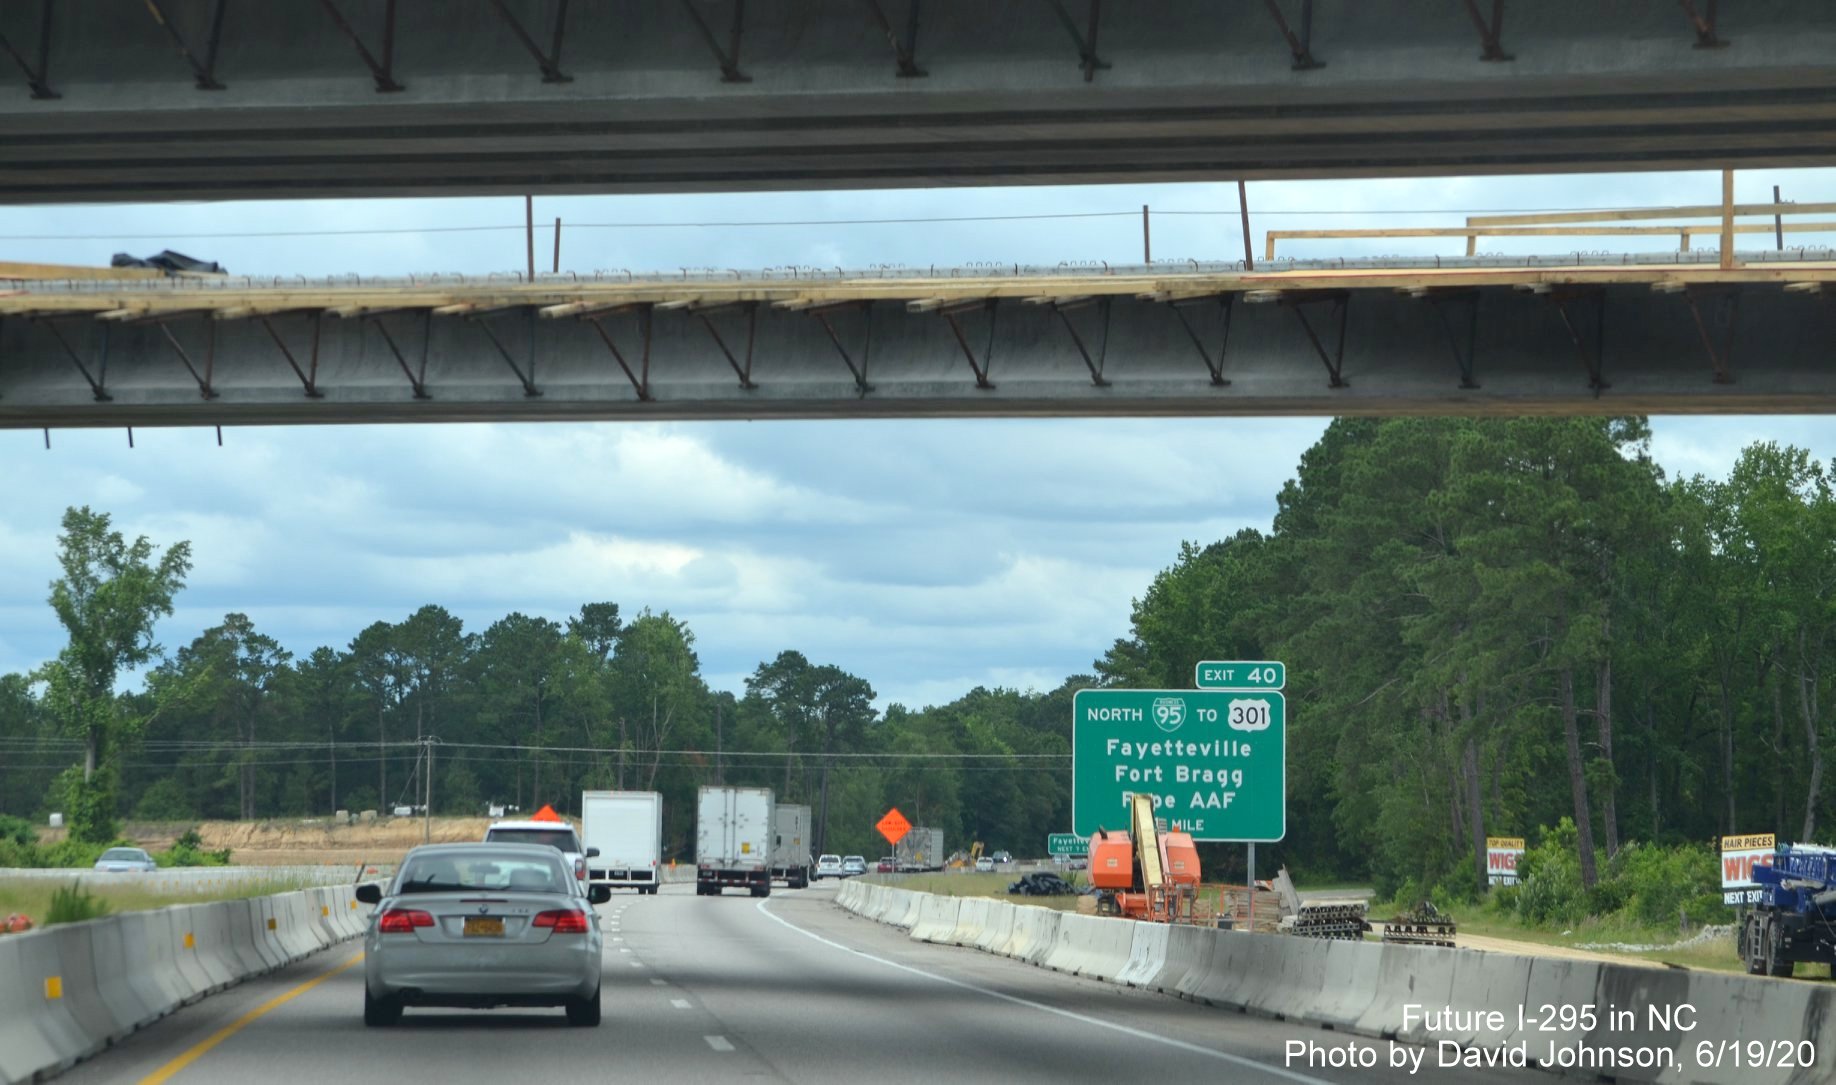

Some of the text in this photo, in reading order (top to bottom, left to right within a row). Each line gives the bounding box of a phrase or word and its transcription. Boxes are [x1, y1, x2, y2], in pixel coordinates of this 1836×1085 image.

[1204, 667, 1277, 684] EXIT 40
[1087, 706, 1267, 725] NORTH 95 TO 301
[1106, 738, 1252, 760] Fayetteville
[1115, 765, 1243, 788] Fort Bragg
[1122, 790, 1236, 812] Ppe AAF
[1171, 819, 1204, 831] MILE
[1724, 836, 1772, 848] HAIR PIECES
[1724, 890, 1763, 904] NEXT EXIT
